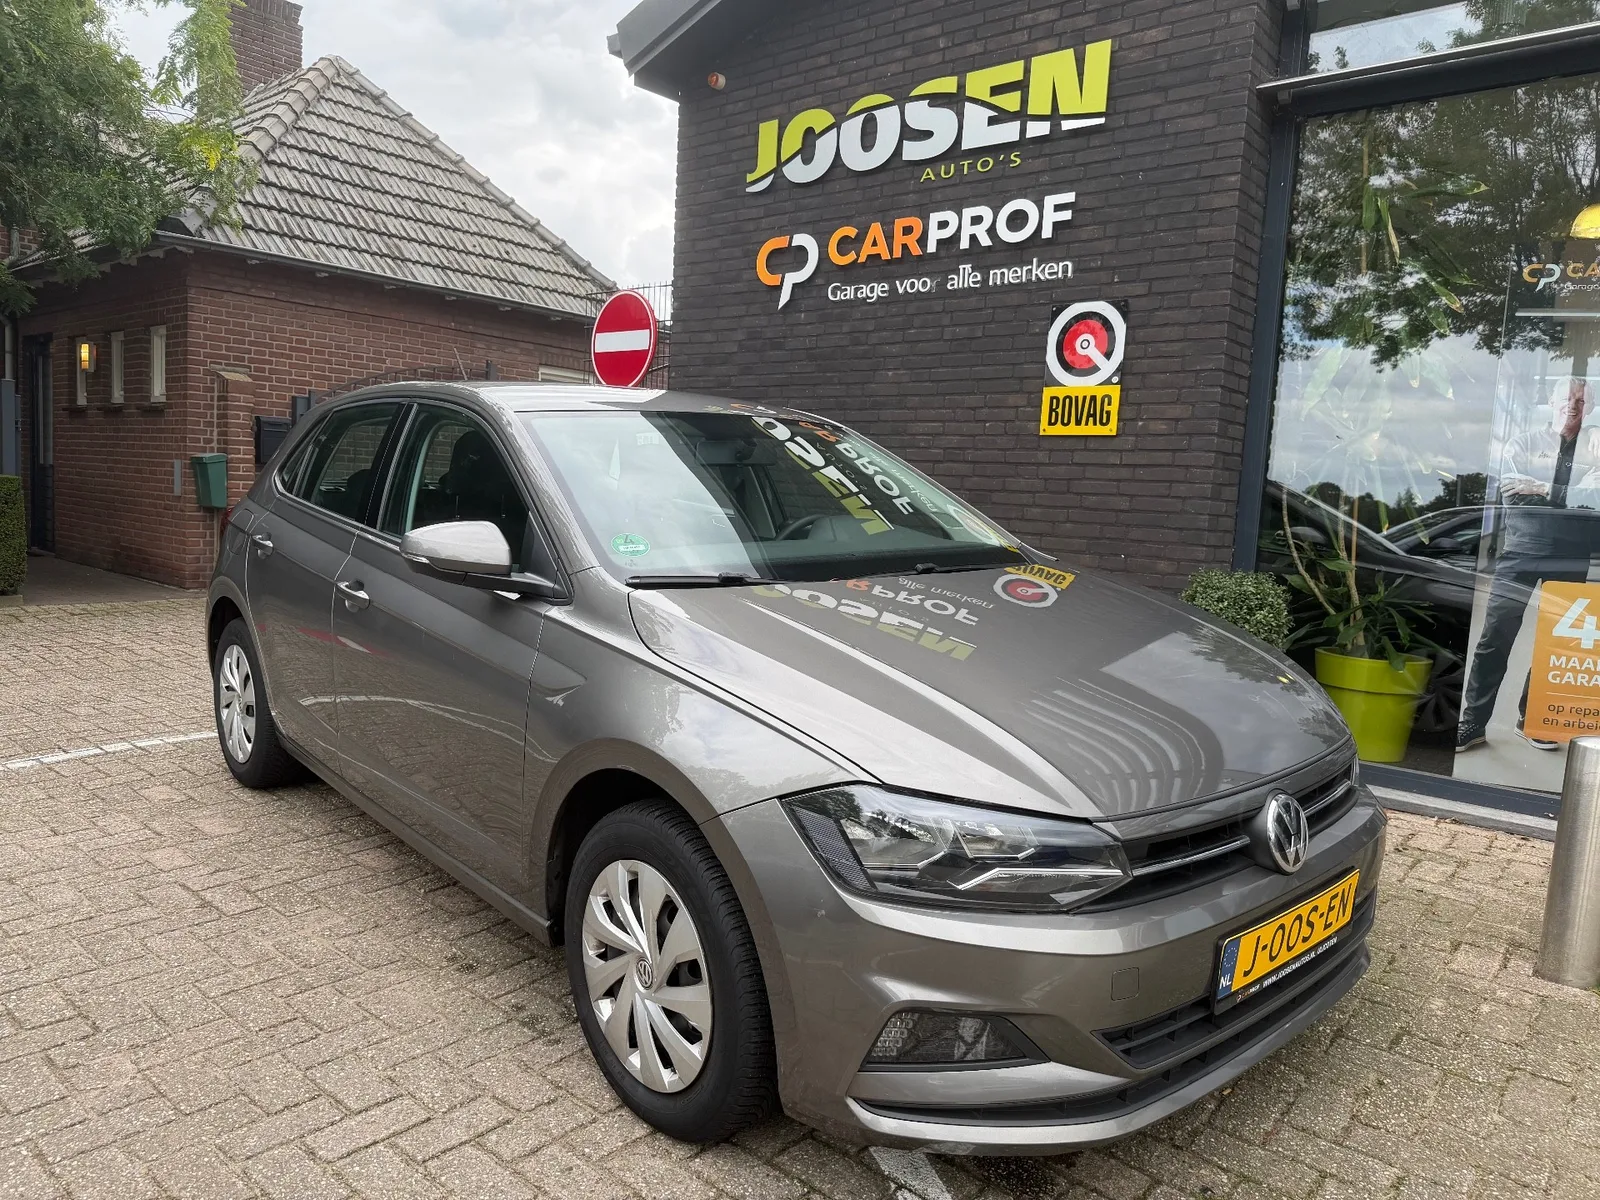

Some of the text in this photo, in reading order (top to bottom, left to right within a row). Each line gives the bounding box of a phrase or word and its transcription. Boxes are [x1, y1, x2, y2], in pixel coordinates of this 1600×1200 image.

[745, 38, 1112, 192] JOOSEN
[919, 152, 1022, 183] AUTO'S
[827, 192, 1076, 266] CARPROF
[827, 282, 889, 302] Garage
[947, 264, 981, 290] alle
[988, 258, 1073, 286] merken
[1047, 394, 1113, 427] BOVAG
[1542, 717, 1559, 727] en
[1547, 704, 1565, 715] op
[1219, 973, 1232, 990] NL
